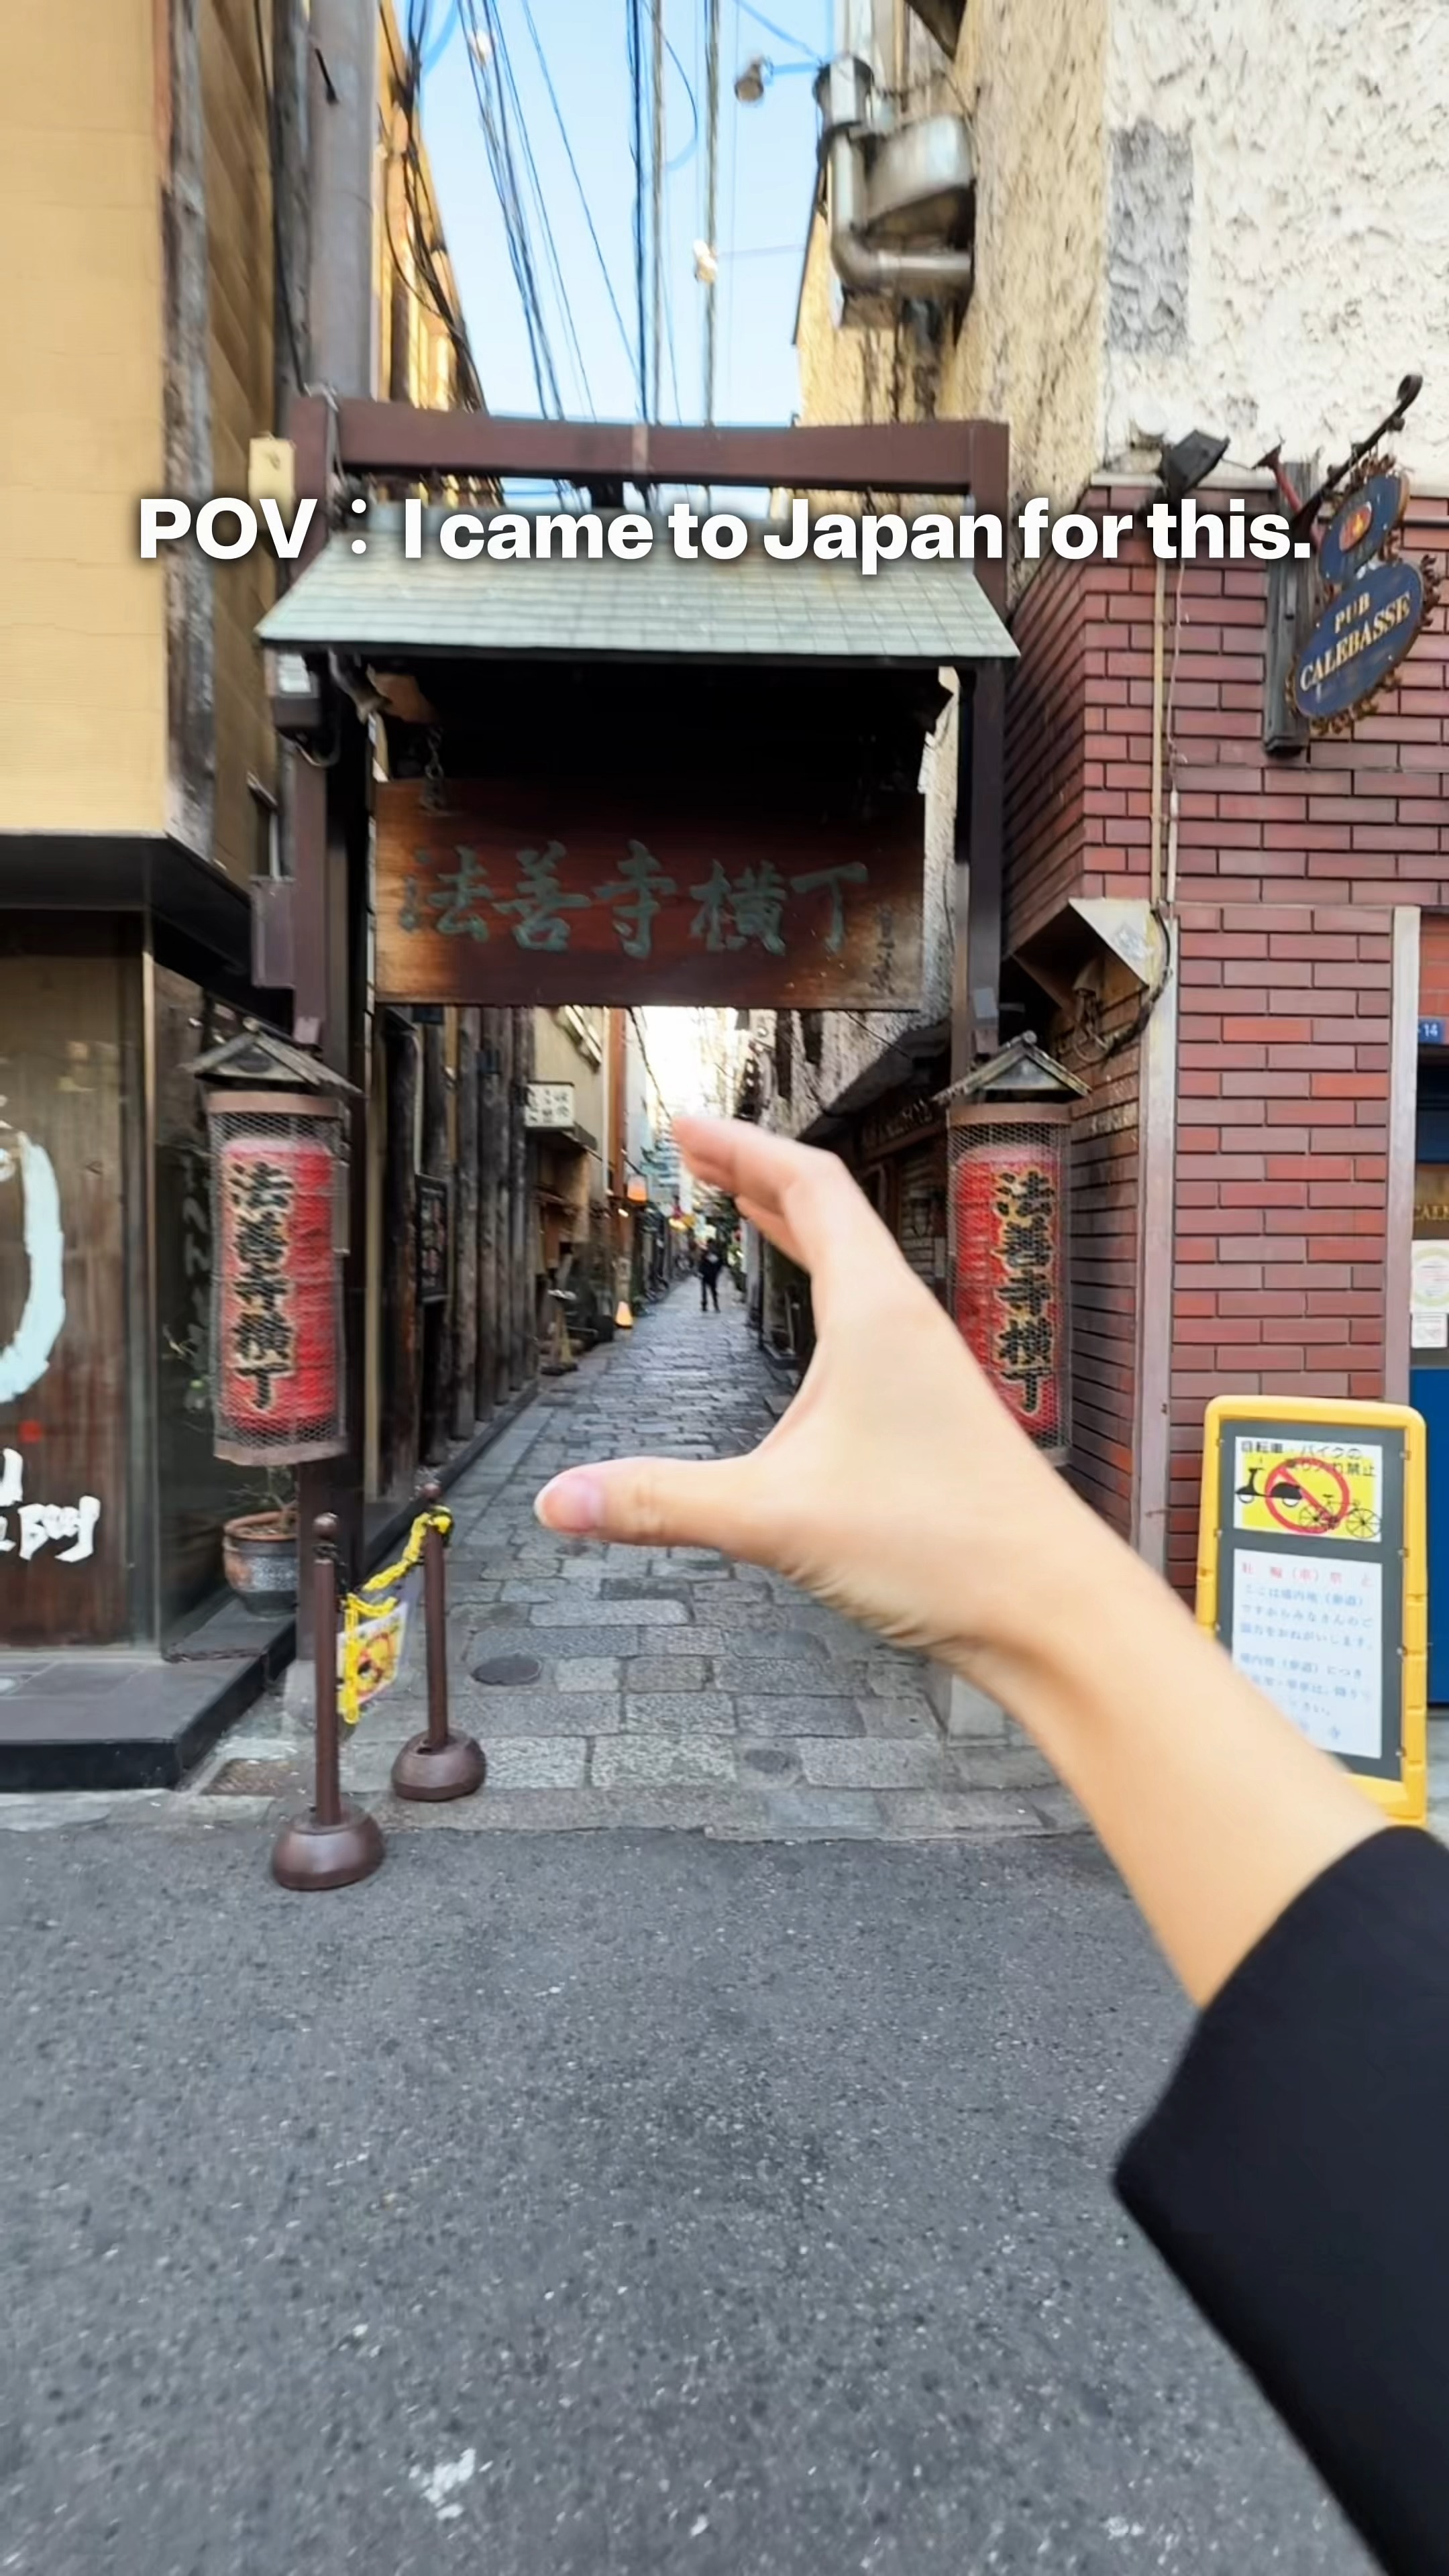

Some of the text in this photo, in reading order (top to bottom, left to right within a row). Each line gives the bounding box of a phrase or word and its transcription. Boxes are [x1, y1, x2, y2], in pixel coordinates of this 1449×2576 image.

[1300, 590, 1410, 692] CALEBASSE
[1334, 592, 1370, 634] PUB
[398, 839, 869, 959] 法善寺横丁
[229, 1161, 294, 1409] 法善寺横丁
[996, 1170, 1055, 1413] 法善寺横丁
